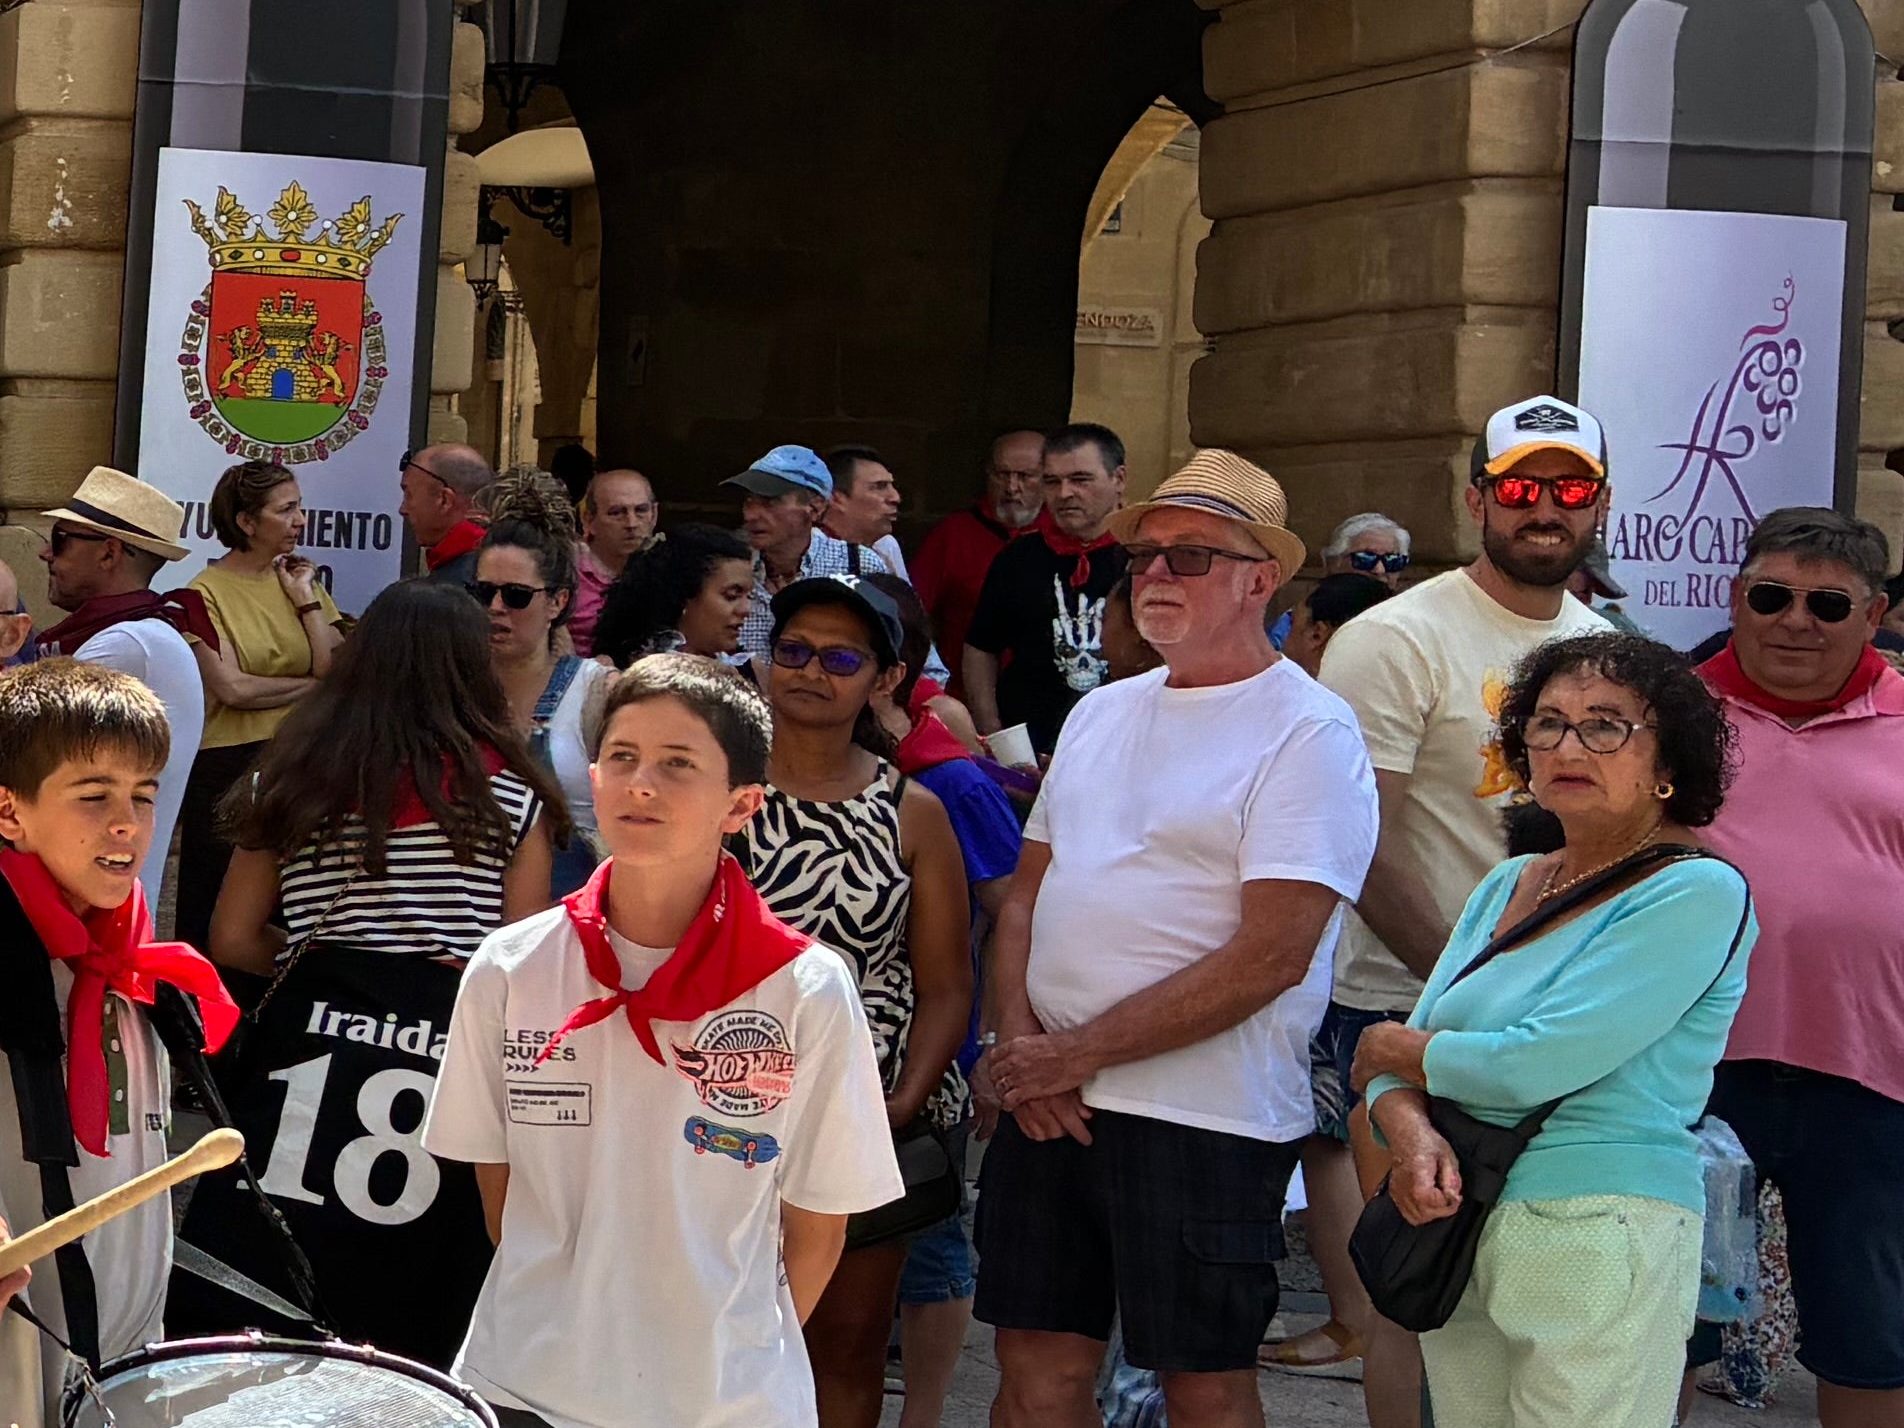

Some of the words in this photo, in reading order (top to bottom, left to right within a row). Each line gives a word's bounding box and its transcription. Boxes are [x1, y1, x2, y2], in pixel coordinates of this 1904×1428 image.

[1609, 512, 1683, 562] ARO
[1644, 579, 1682, 607] DEL
[1685, 572, 1732, 609] RIO
[305, 1000, 450, 1061] Iraida
[726, 1016, 758, 1027] MADE
[759, 1018, 775, 1032] ME
[236, 1052, 441, 1226] 18
